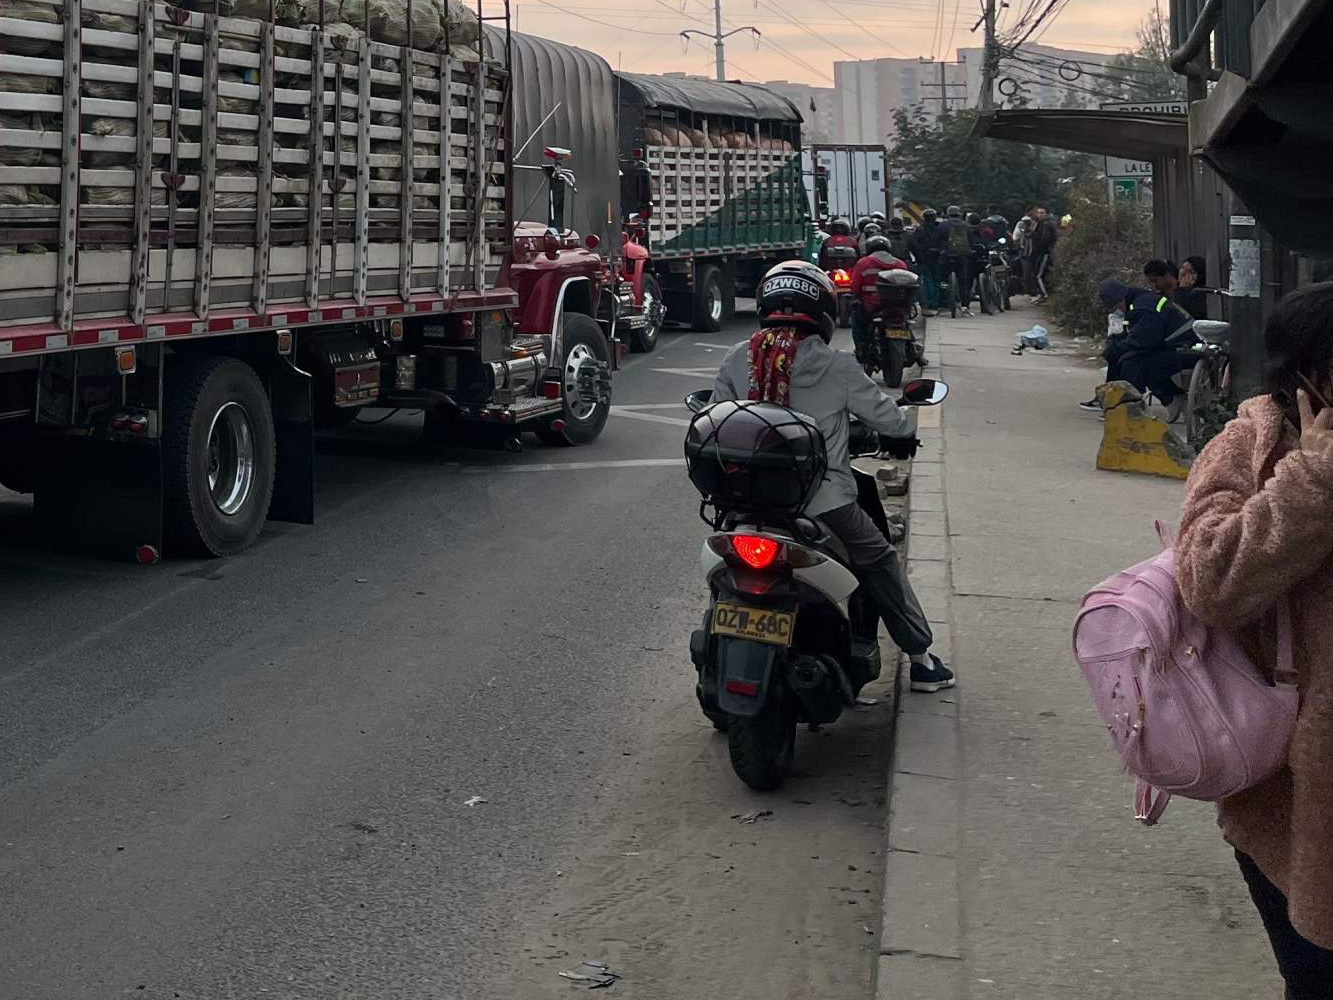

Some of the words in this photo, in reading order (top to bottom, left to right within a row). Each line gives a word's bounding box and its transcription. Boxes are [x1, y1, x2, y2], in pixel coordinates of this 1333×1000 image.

[1125, 163, 1137, 173] LA
[1140, 163, 1152, 173] LE
[764, 278, 818, 297] QZW68C
